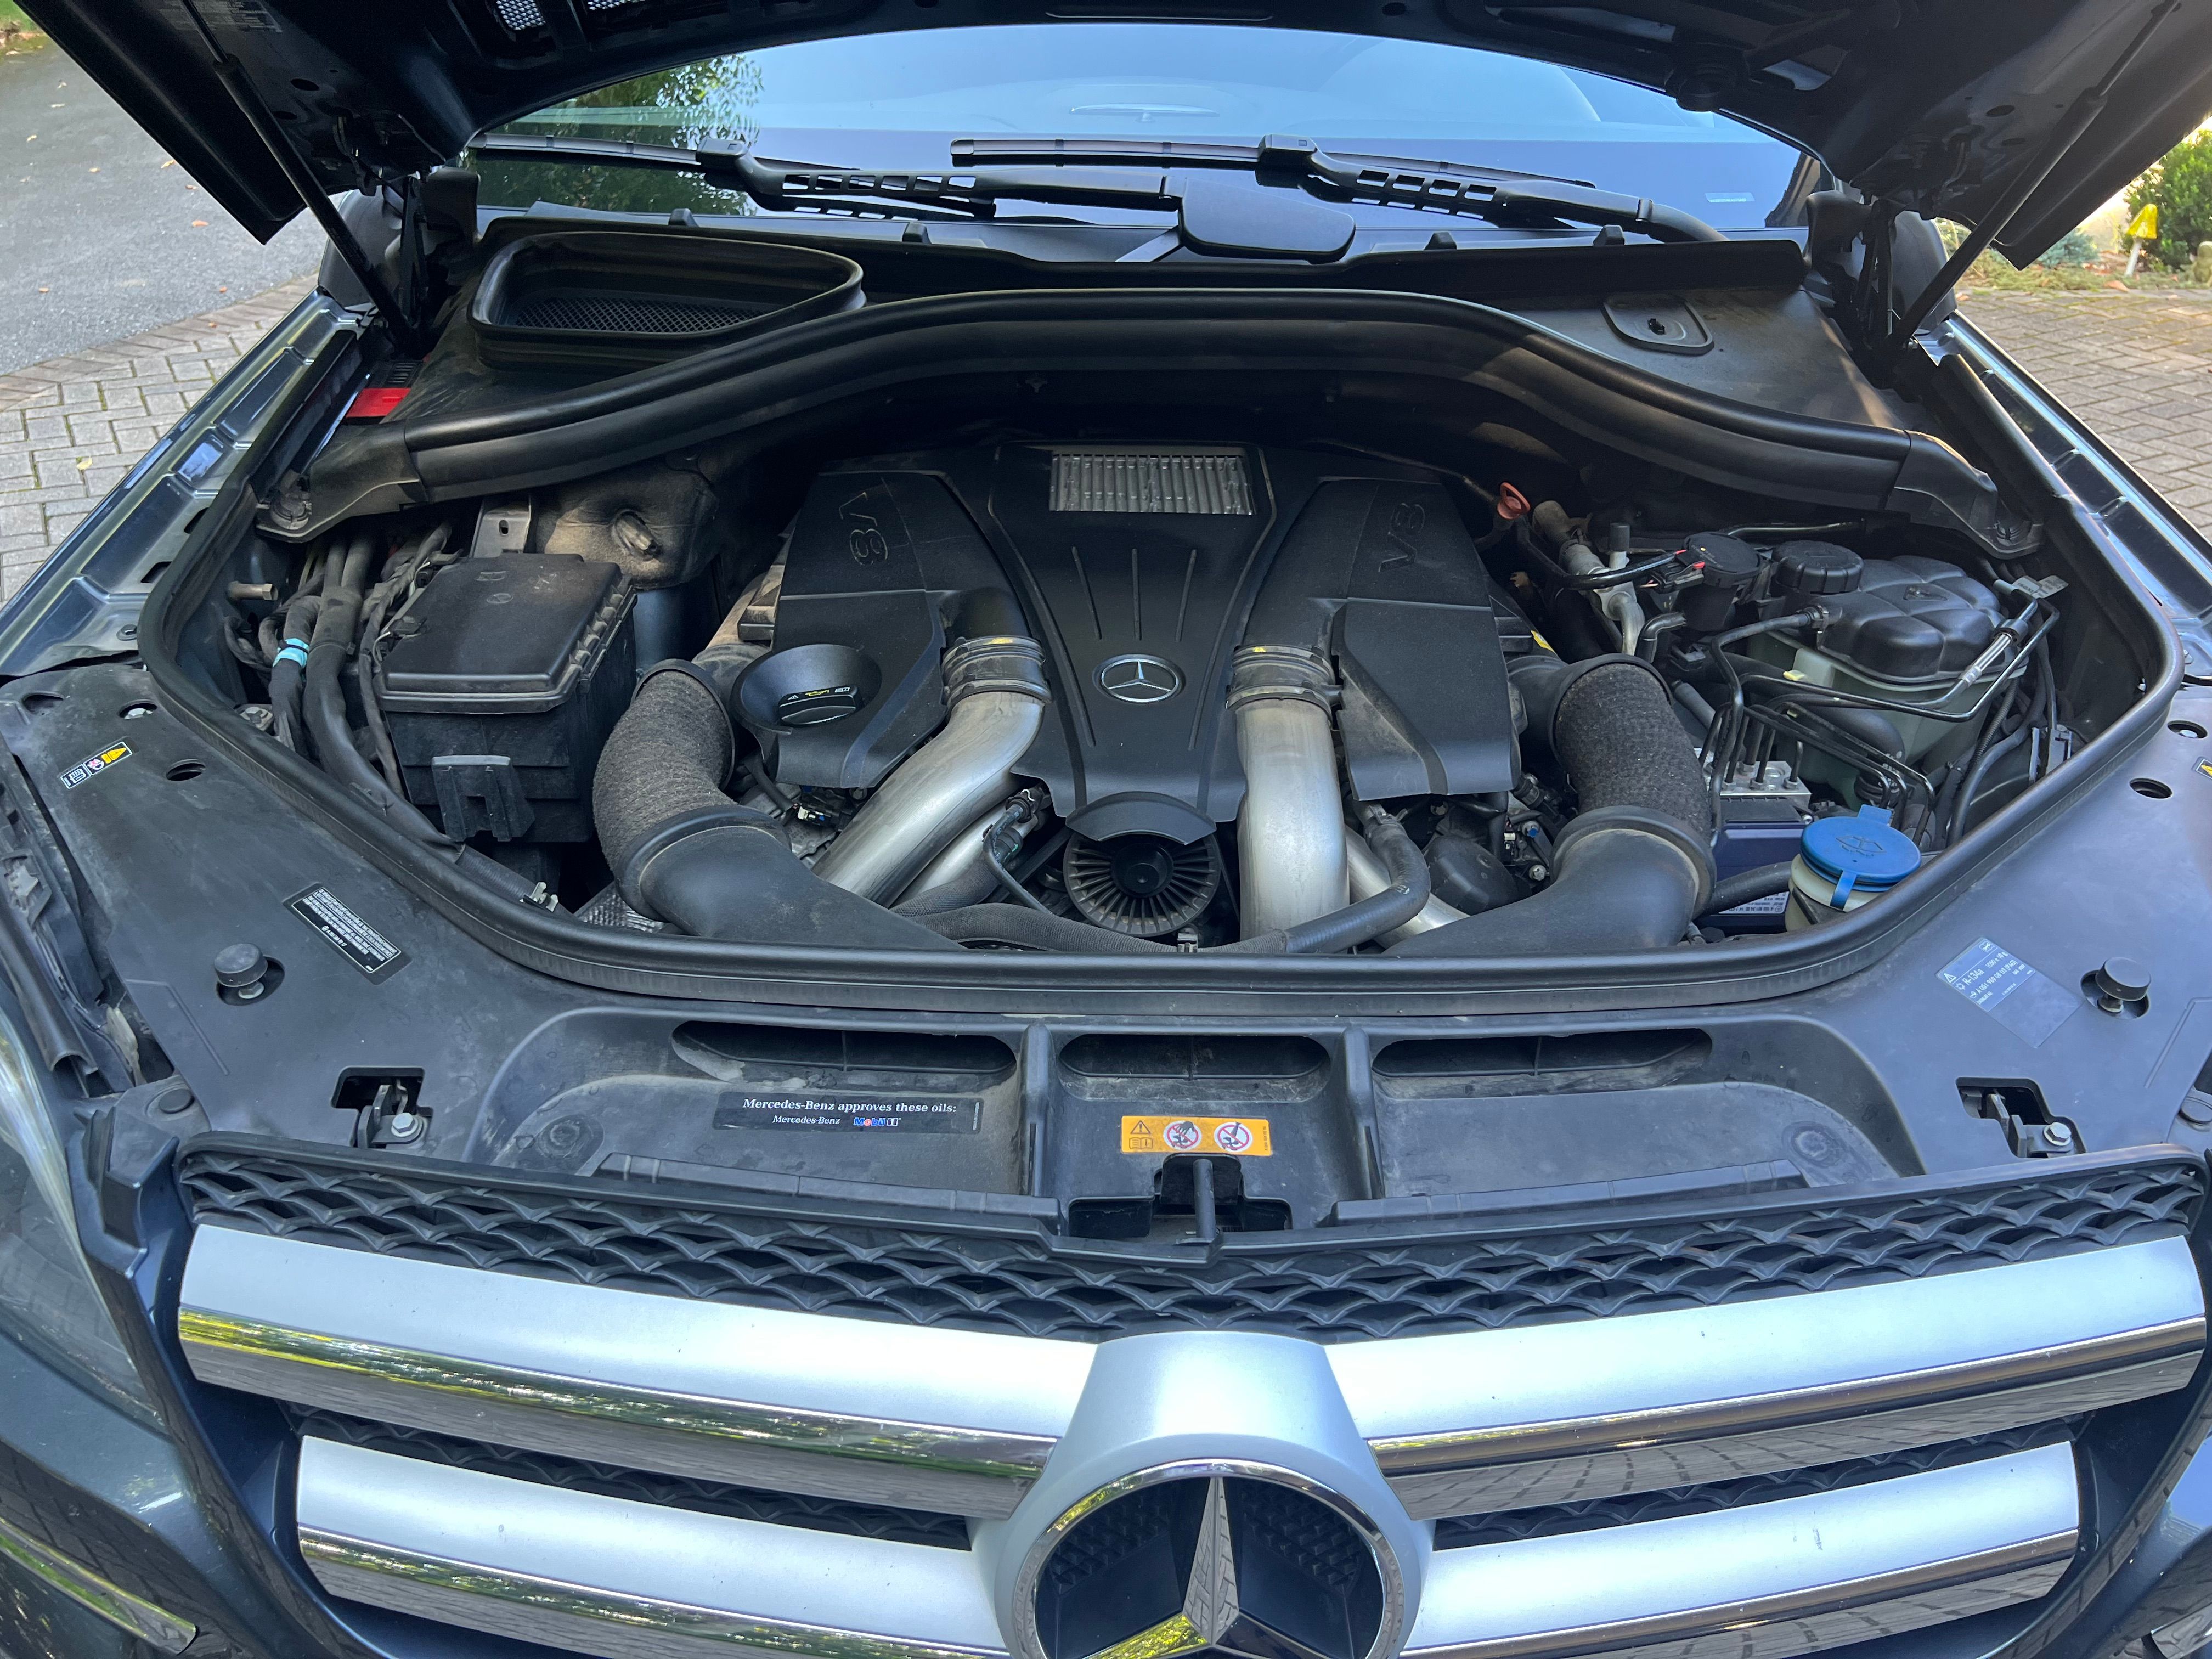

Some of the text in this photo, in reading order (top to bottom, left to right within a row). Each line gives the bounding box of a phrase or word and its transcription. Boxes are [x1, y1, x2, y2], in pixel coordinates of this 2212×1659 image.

[838, 492, 888, 566] V8
[1378, 502, 1426, 573] V8
[2004, 960, 2019, 971] (PAG)
[1962, 969, 1984, 985] R-134a
[742, 1098, 957, 1114] Mercedes-Benz approves these oils:
[772, 1115, 841, 1125] Mercedes-Benz
[853, 1117, 886, 1127] Mobil
